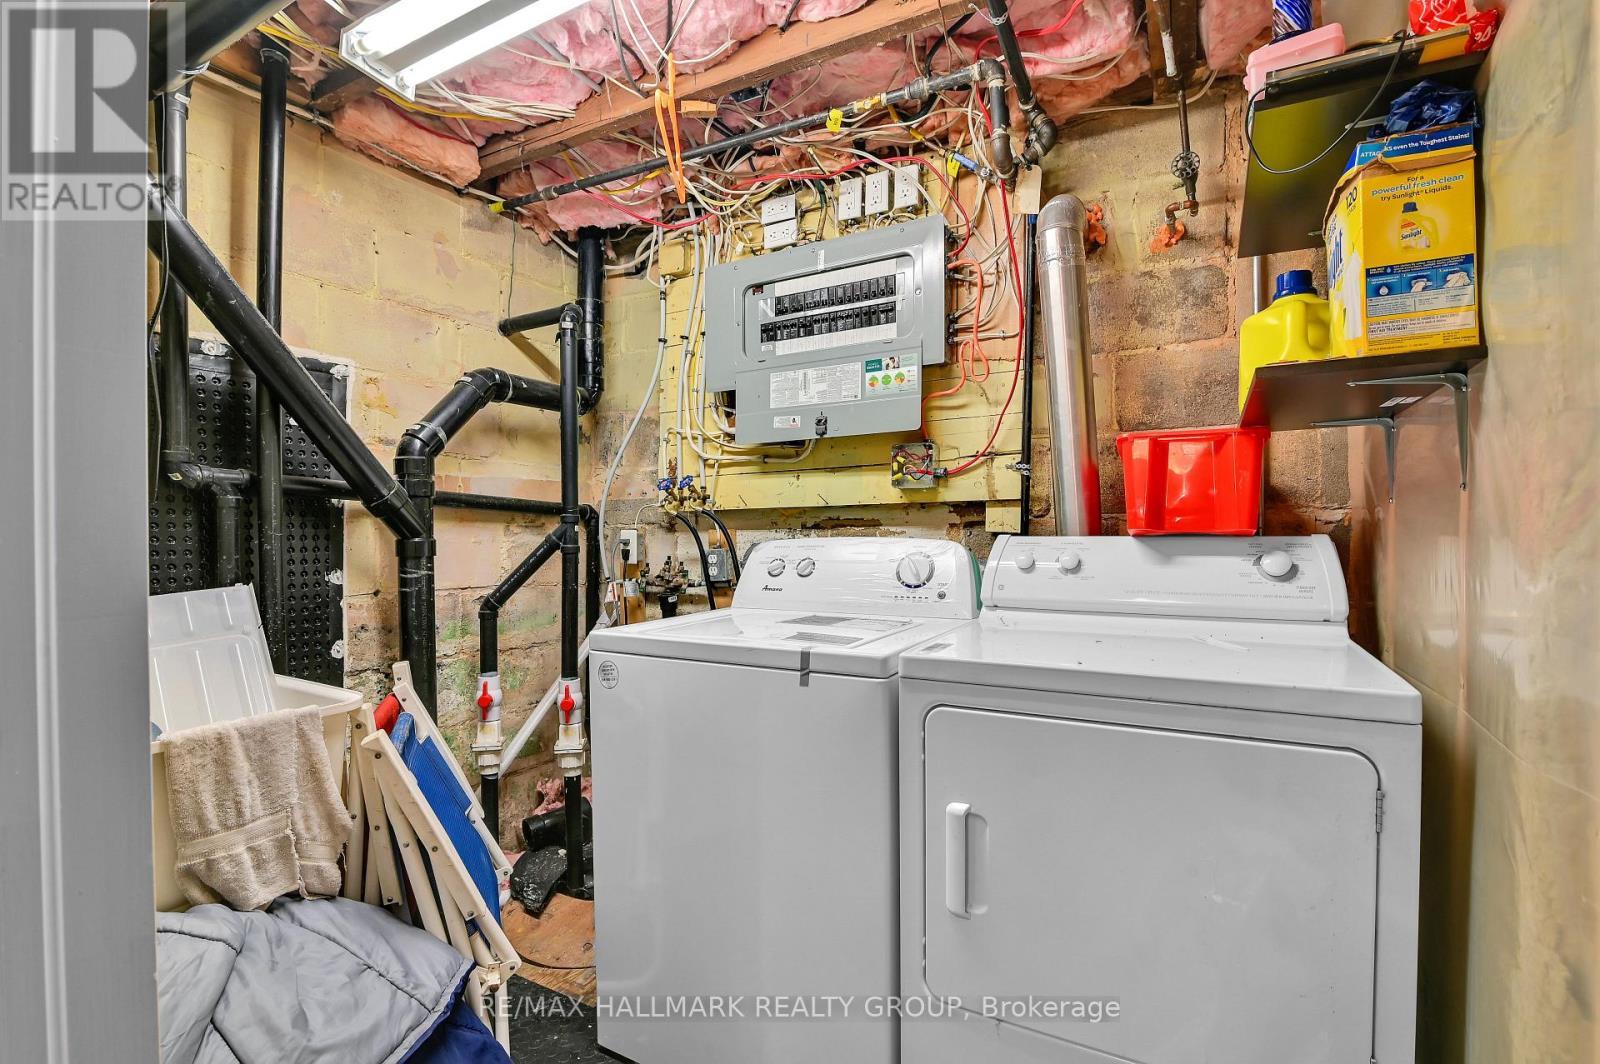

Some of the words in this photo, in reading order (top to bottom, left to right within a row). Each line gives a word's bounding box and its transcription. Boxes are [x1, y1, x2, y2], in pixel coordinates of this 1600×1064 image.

[1393, 143, 1408, 151] even
[1408, 141, 1419, 149] the
[1420, 136, 1447, 147] Toughest
[1371, 183, 1411, 196] powerful
[1413, 179, 1437, 188] fresh
[1438, 174, 1464, 183] clean
